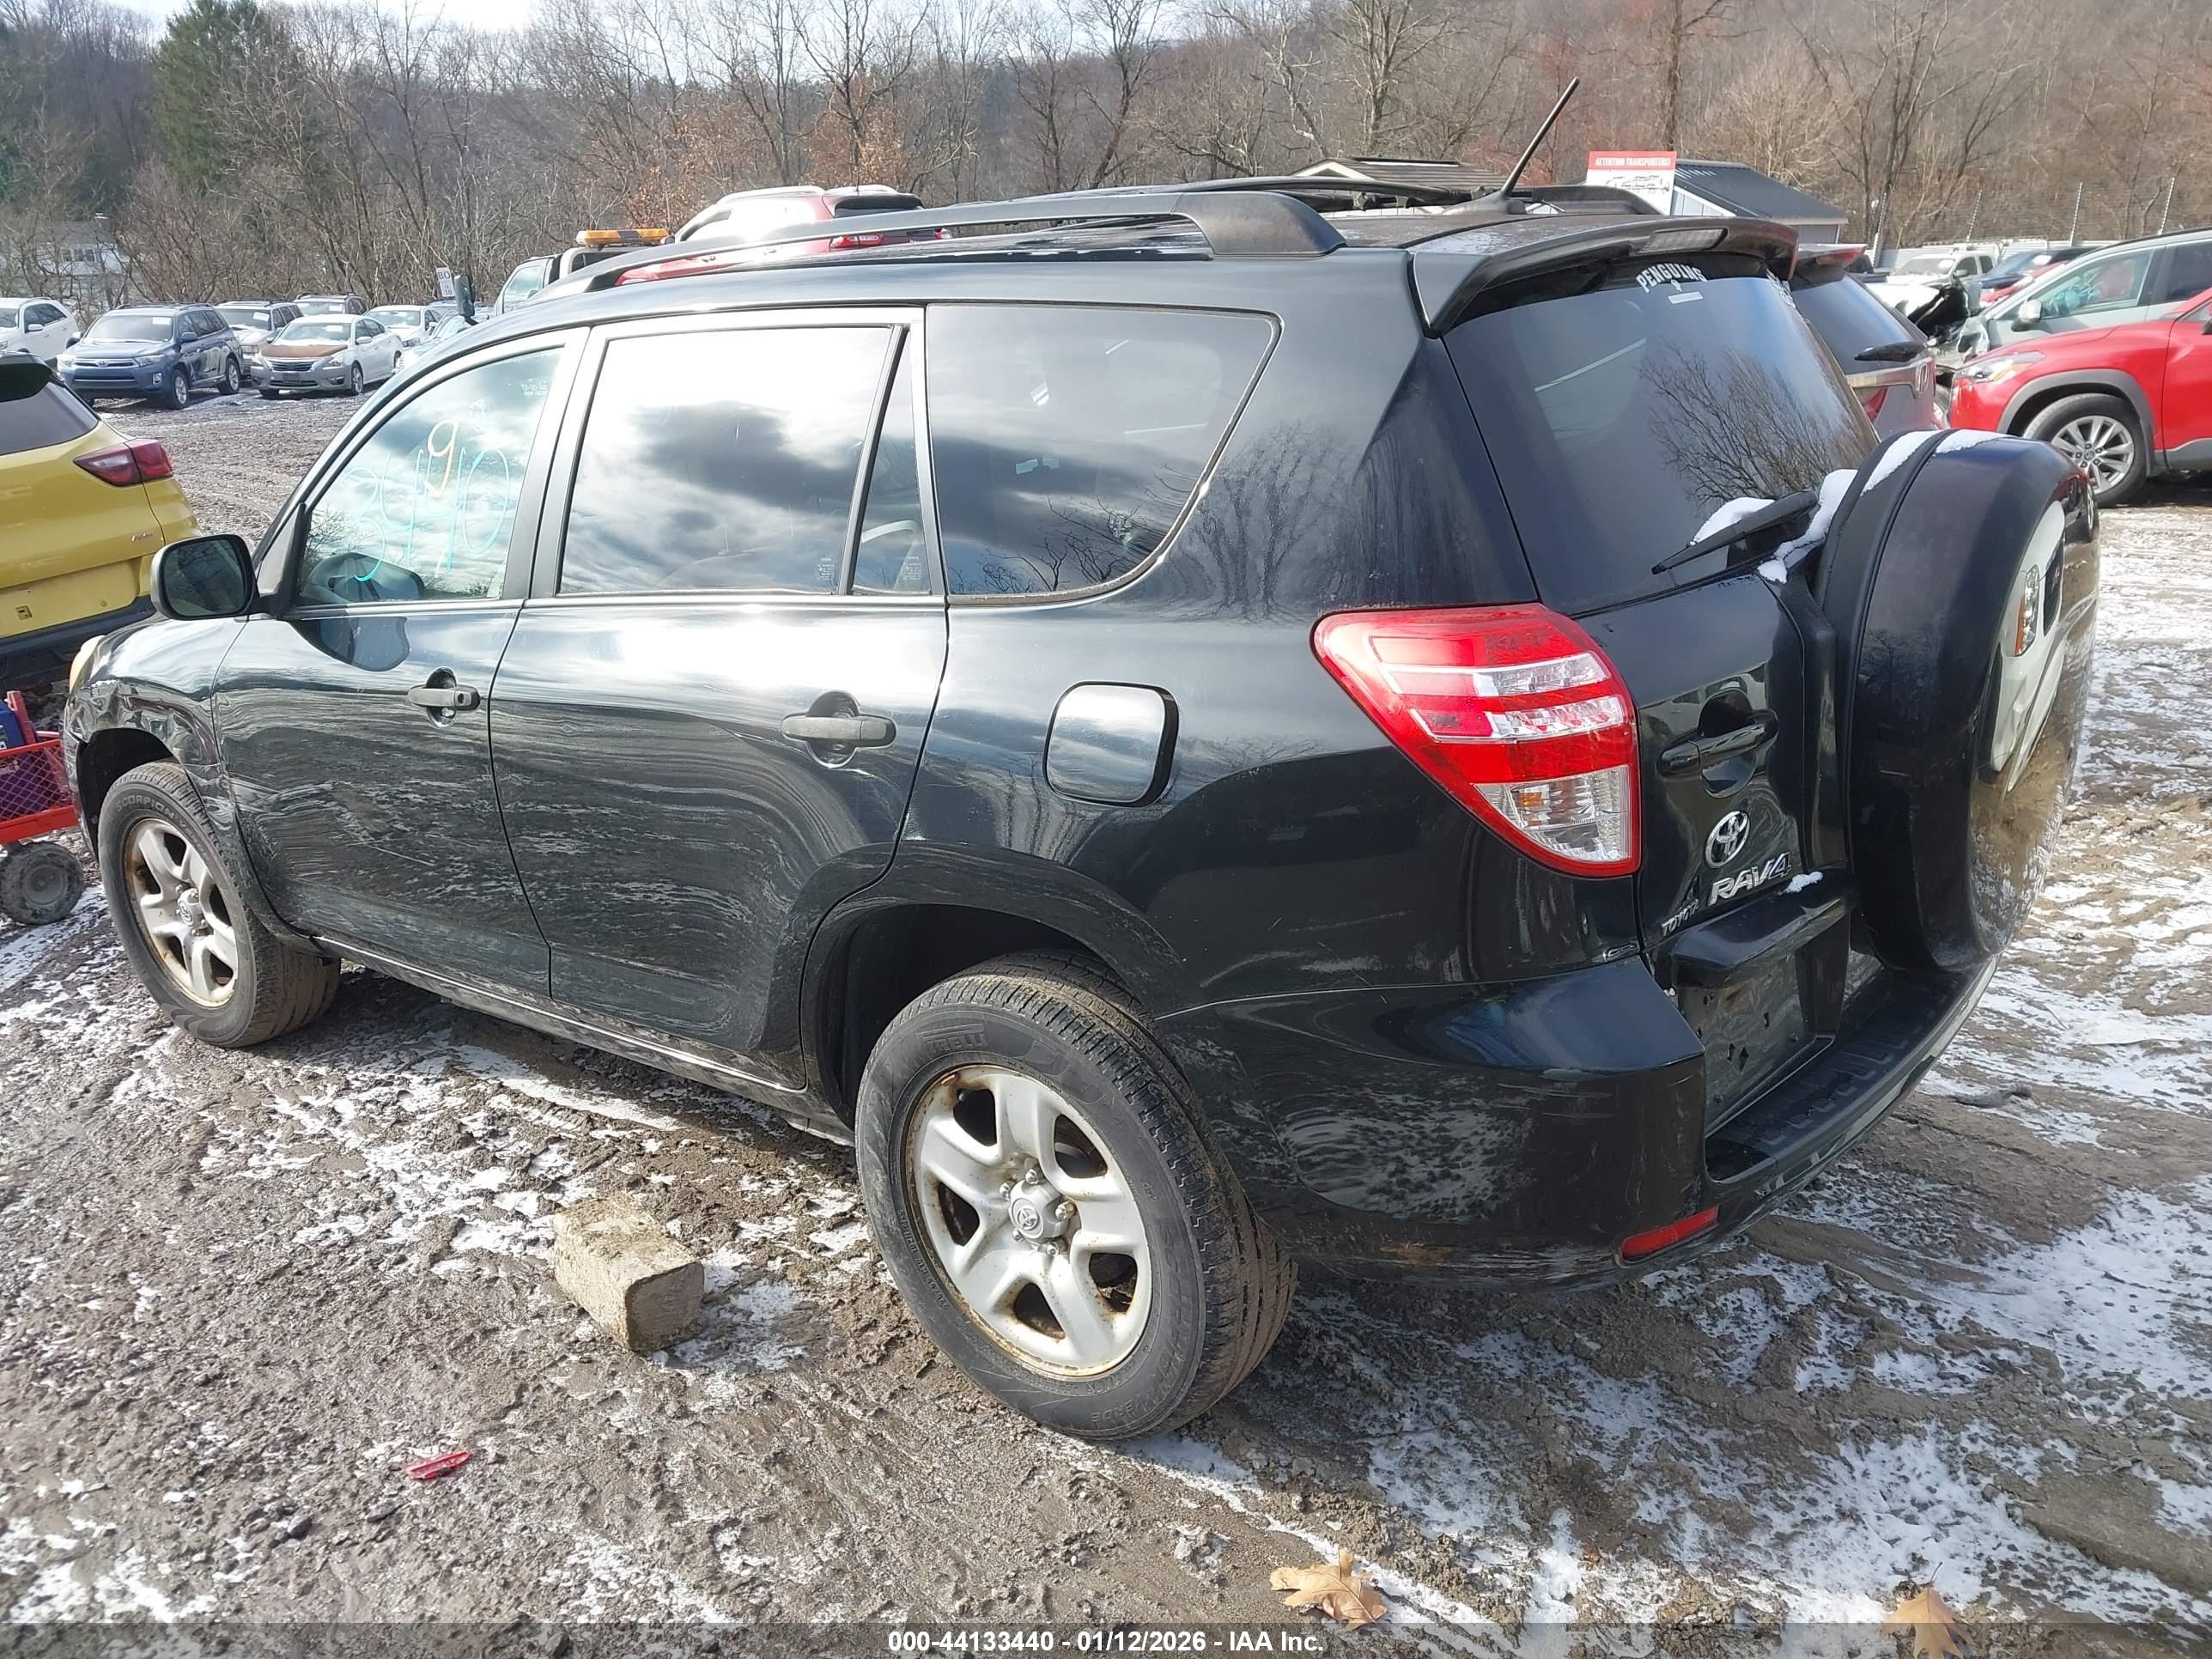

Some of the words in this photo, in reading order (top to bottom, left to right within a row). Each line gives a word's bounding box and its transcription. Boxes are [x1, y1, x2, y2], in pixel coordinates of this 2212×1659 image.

[1636, 263, 1708, 293] PENGUINS
[428, 418, 459, 500] 9
[1707, 851, 1792, 907] RAV4
[1661, 898, 1699, 937] TOYOTA
